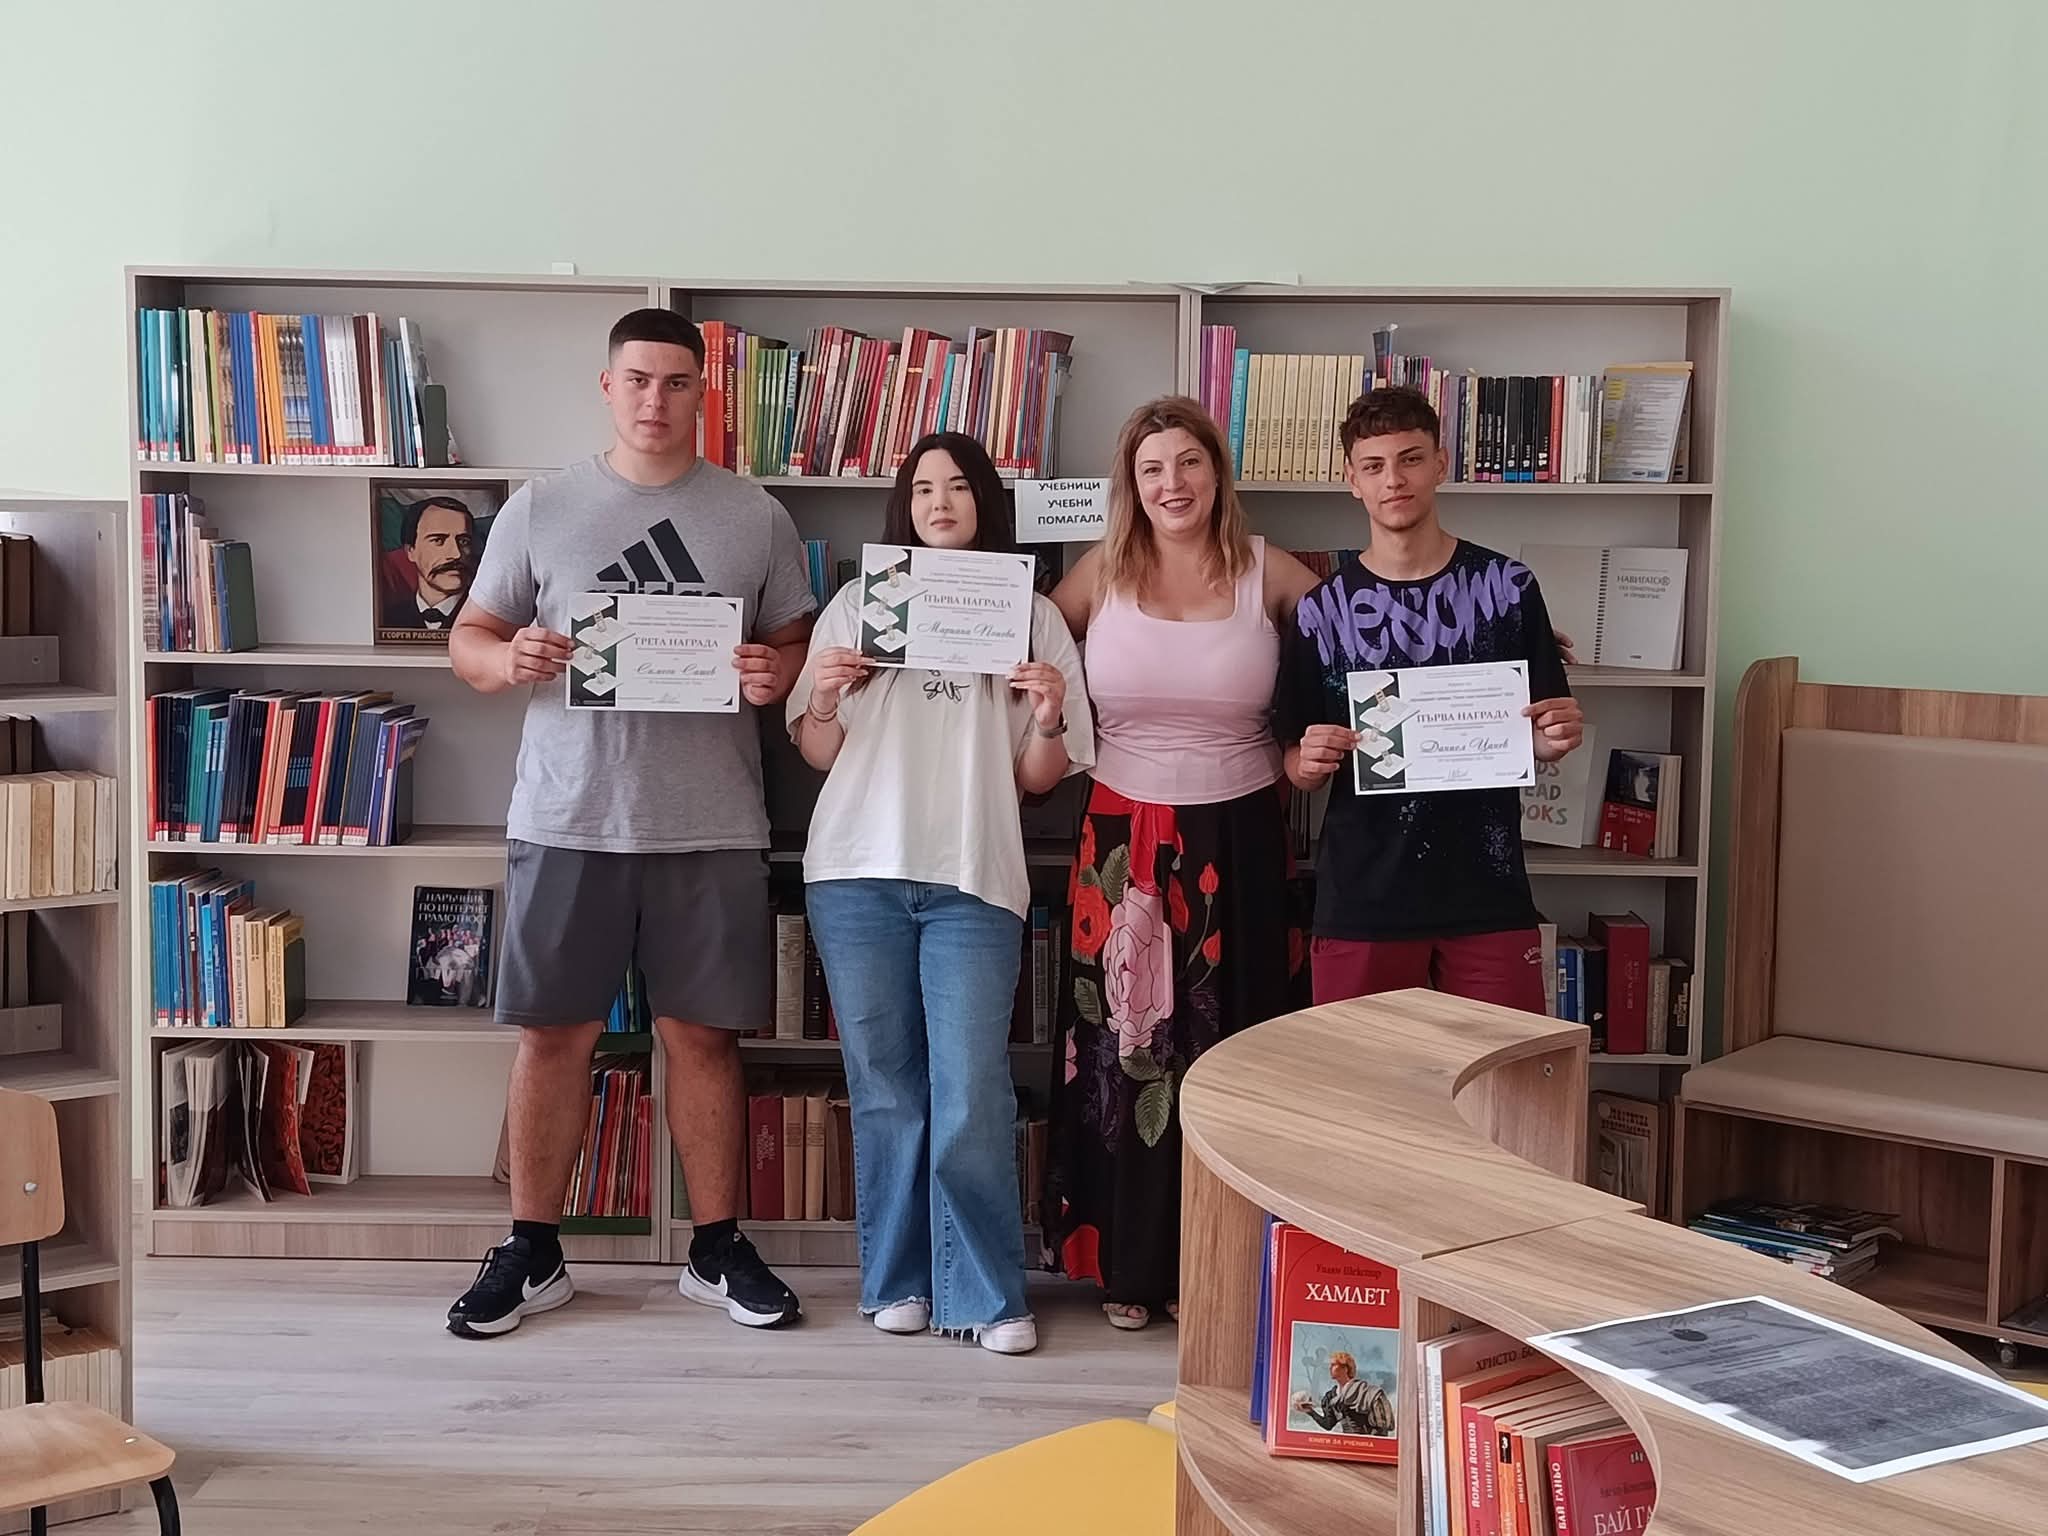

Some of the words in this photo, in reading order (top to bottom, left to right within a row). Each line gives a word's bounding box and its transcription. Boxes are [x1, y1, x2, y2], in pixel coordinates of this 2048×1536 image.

[1038, 482, 1100, 491] УЧЕБНИЦИ
[1047, 499, 1092, 508] УЧЕБНИ
[1037, 514, 1104, 525] ПОМАГАЛА
[924, 594, 961, 605] ПЪРВА
[963, 596, 1012, 609] НАГРАДА
[634, 637, 666, 647] ТРЕТА
[669, 638, 719, 649] НАГРАДА
[1417, 711, 1455, 723] ПЪРВА
[1458, 710, 1510, 721] НАГРАДА
[1536, 760, 1560, 777] DS
[1524, 783, 1561, 800] EAD
[1521, 803, 1568, 825] OKS
[418, 903, 436, 912] ПО
[1305, 1282, 1390, 1306] ХАМЛЕТ
[1475, 1350, 1517, 1372] ХРИСТО
[1467, 1421, 1478, 1463] ЙОВКОВ
[1470, 1467, 1481, 1508] ЙОРДАН
[1551, 1462, 1565, 1502] ГАНЬО
[1556, 1505, 1567, 1530] БАЙ
[1593, 1505, 1632, 1536] БАЙ
[1635, 1505, 1654, 1529] ГА
